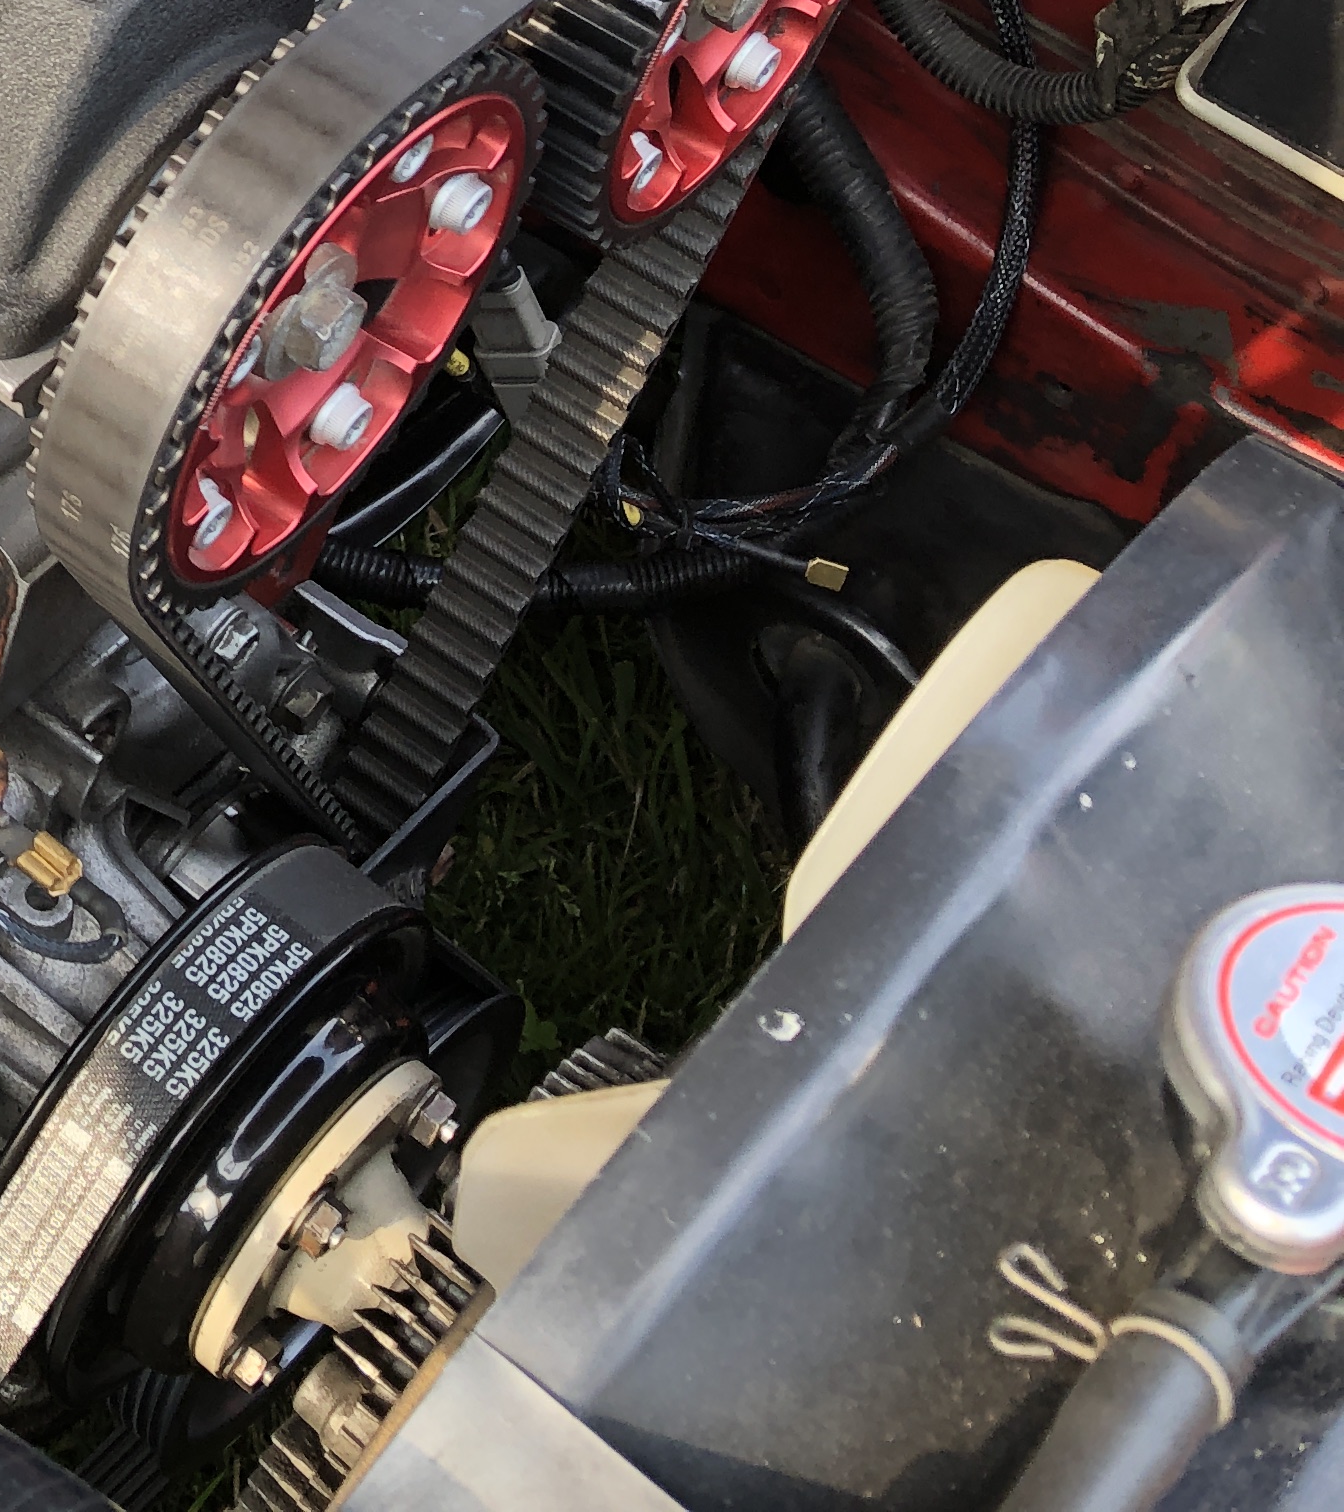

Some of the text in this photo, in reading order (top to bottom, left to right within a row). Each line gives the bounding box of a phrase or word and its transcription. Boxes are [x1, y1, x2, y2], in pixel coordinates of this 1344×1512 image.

[60, 489, 82, 522] 176
[109, 522, 131, 559] 176
[185, 907, 268, 987] 5PK0825
[207, 924, 290, 1004] 5PK0825
[230, 942, 313, 1022] 5PK0825
[1253, 925, 1338, 1040] CAUTION
[120, 991, 184, 1064] 325K5
[142, 1008, 206, 1081] 325K5
[165, 1027, 230, 1100] 325K5
[133, 1121, 159, 1151] Made
